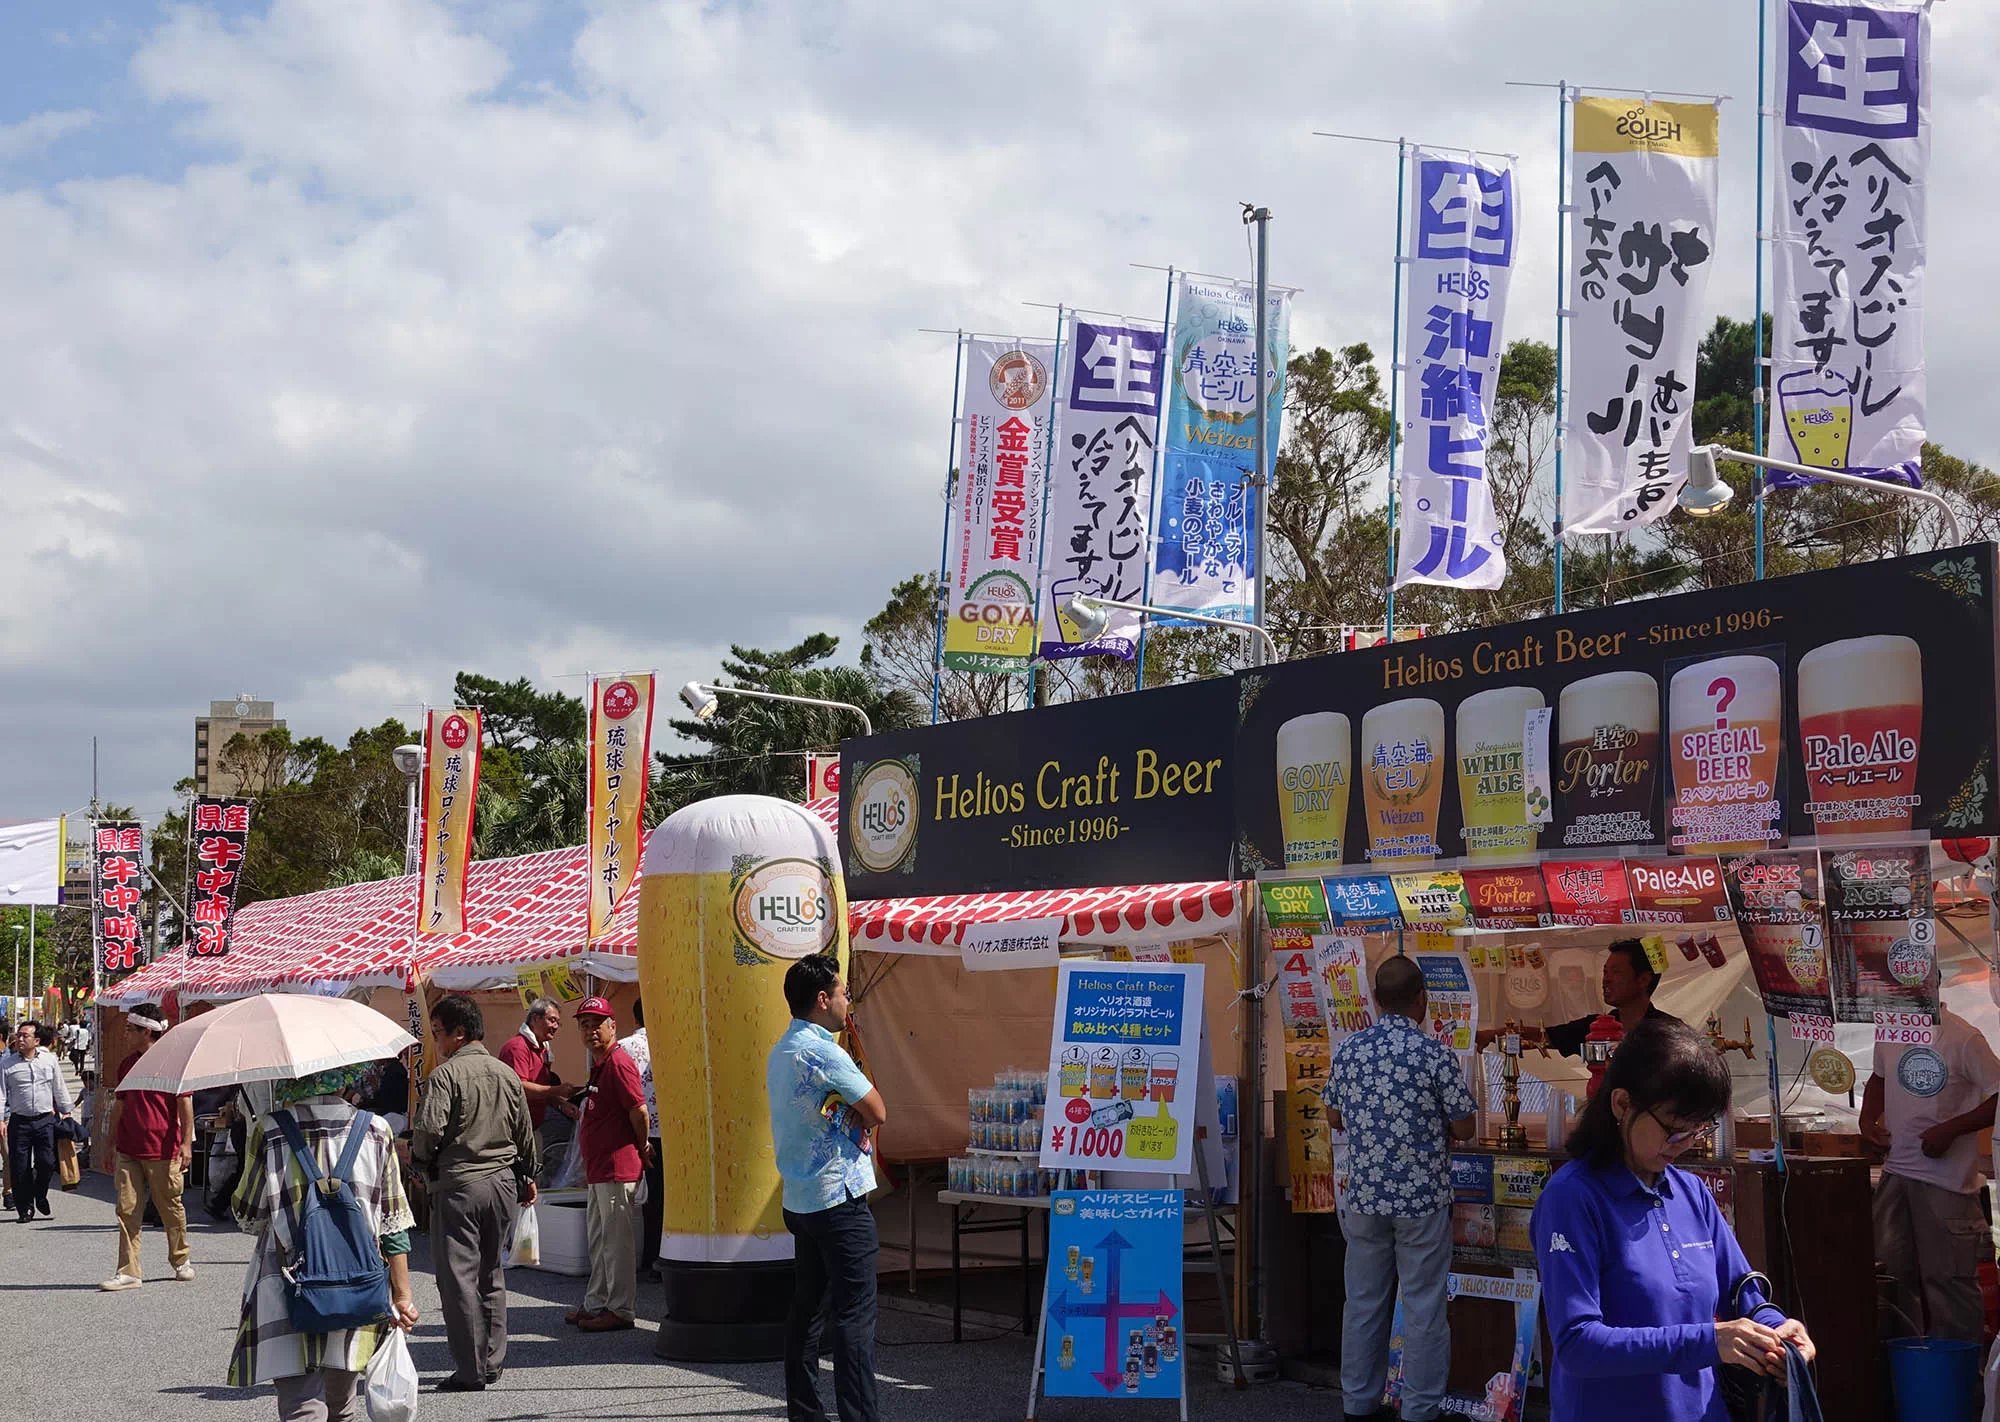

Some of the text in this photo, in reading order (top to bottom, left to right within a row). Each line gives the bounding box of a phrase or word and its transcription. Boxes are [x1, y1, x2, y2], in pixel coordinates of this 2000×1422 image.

[1798, 19, 1907, 124] 生
[1428, 172, 1505, 254] 生
[1791, 155, 1848, 379] 冷えてます。
[1848, 143, 1912, 416] ヘリオスビール
[1188, 285, 1253, 303] Helios Craft
[1218, 317, 1248, 333] HELIOS
[1217, 336, 1246, 344] OKINAWA
[1082, 334, 1155, 406] 生
[1200, 379, 1255, 403] ビール
[1804, 409, 1834, 424] HELIOS
[975, 415, 991, 524] ビアフェス横浜2011
[989, 416, 1030, 561] 金賞受賞
[1066, 428, 1113, 583] 冷えてます。
[1101, 416, 1153, 602] ヘリオスビール
[1180, 477, 1204, 585] 小麦のビール
[1203, 481, 1225, 577] さわやかな
[1222, 484, 1244, 593] フルーティーで
[988, 584, 1016, 598] HELIOS
[959, 603, 1034, 627] GOYA
[977, 626, 1019, 644] DRY
[1383, 653, 1464, 689] Helios
[1472, 636, 1544, 675] Craft
[1555, 628, 1627, 664] Beer
[1593, 724, 1639, 752] 星空の
[1682, 728, 1764, 759] SPECIAL
[1372, 738, 1433, 771] 青い空と海の
[1283, 762, 1345, 791] GOYA
[1385, 770, 1419, 790] ビール
[1558, 745, 1649, 793] Porter
[1697, 755, 1750, 784] BEER
[1819, 768, 1902, 785] ペールエール
[934, 748, 1222, 821] Helios Craft Beer
[1477, 774, 1524, 796] ALE
[1590, 788, 1623, 798] ポーター
[1681, 782, 1768, 803] スペシャルビール
[1293, 789, 1333, 814] DRY
[196, 804, 249, 832] 県産
[601, 725, 627, 929] 琉球ロイヤルポーク
[863, 799, 905, 833] HELIOS
[1380, 809, 1424, 825] Weizen
[97, 828, 142, 852] 県産
[430, 755, 462, 928] 琉球ロイヤルポーク
[1558, 867, 1605, 891] 肉専用
[1738, 864, 1800, 884] CASK
[1842, 860, 1909, 879] CASK
[194, 836, 243, 954] 牛中味汁
[1270, 886, 1314, 900] GOYA
[1335, 881, 1387, 899] 青い空と海の
[1407, 892, 1459, 904] WHITE
[1480, 883, 1536, 905] Porter
[102, 856, 141, 969] 牛中味汁
[759, 892, 825, 925] HELIOS
[1279, 901, 1310, 914] DRY
[1346, 897, 1378, 910] ビール
[1419, 903, 1451, 914] ALE
[1831, 908, 1927, 920] ラムカスクエイジ
[968, 936, 1049, 953] ヘリオス酒造株式会社
[1273, 937, 1311, 948] 選べる
[1078, 979, 1176, 992] Helios Craft Beer
[1073, 1006, 1175, 1018] オリジナルクラフトビール
[1098, 996, 1152, 1007] ヘリオス酒造
[1072, 1021, 1172, 1037] 飲み比べ4種セット
[1052, 1125, 1123, 1158] ¥1,000
[1500, 1174, 1541, 1185] WHITE
[1507, 1185, 1531, 1193] ALE
[1081, 1193, 1177, 1204] ヘリオスビール
[1080, 1207, 1179, 1219] 美味しさガイド
[1460, 1280, 1534, 1298] HELIOS CRAFT BEER
